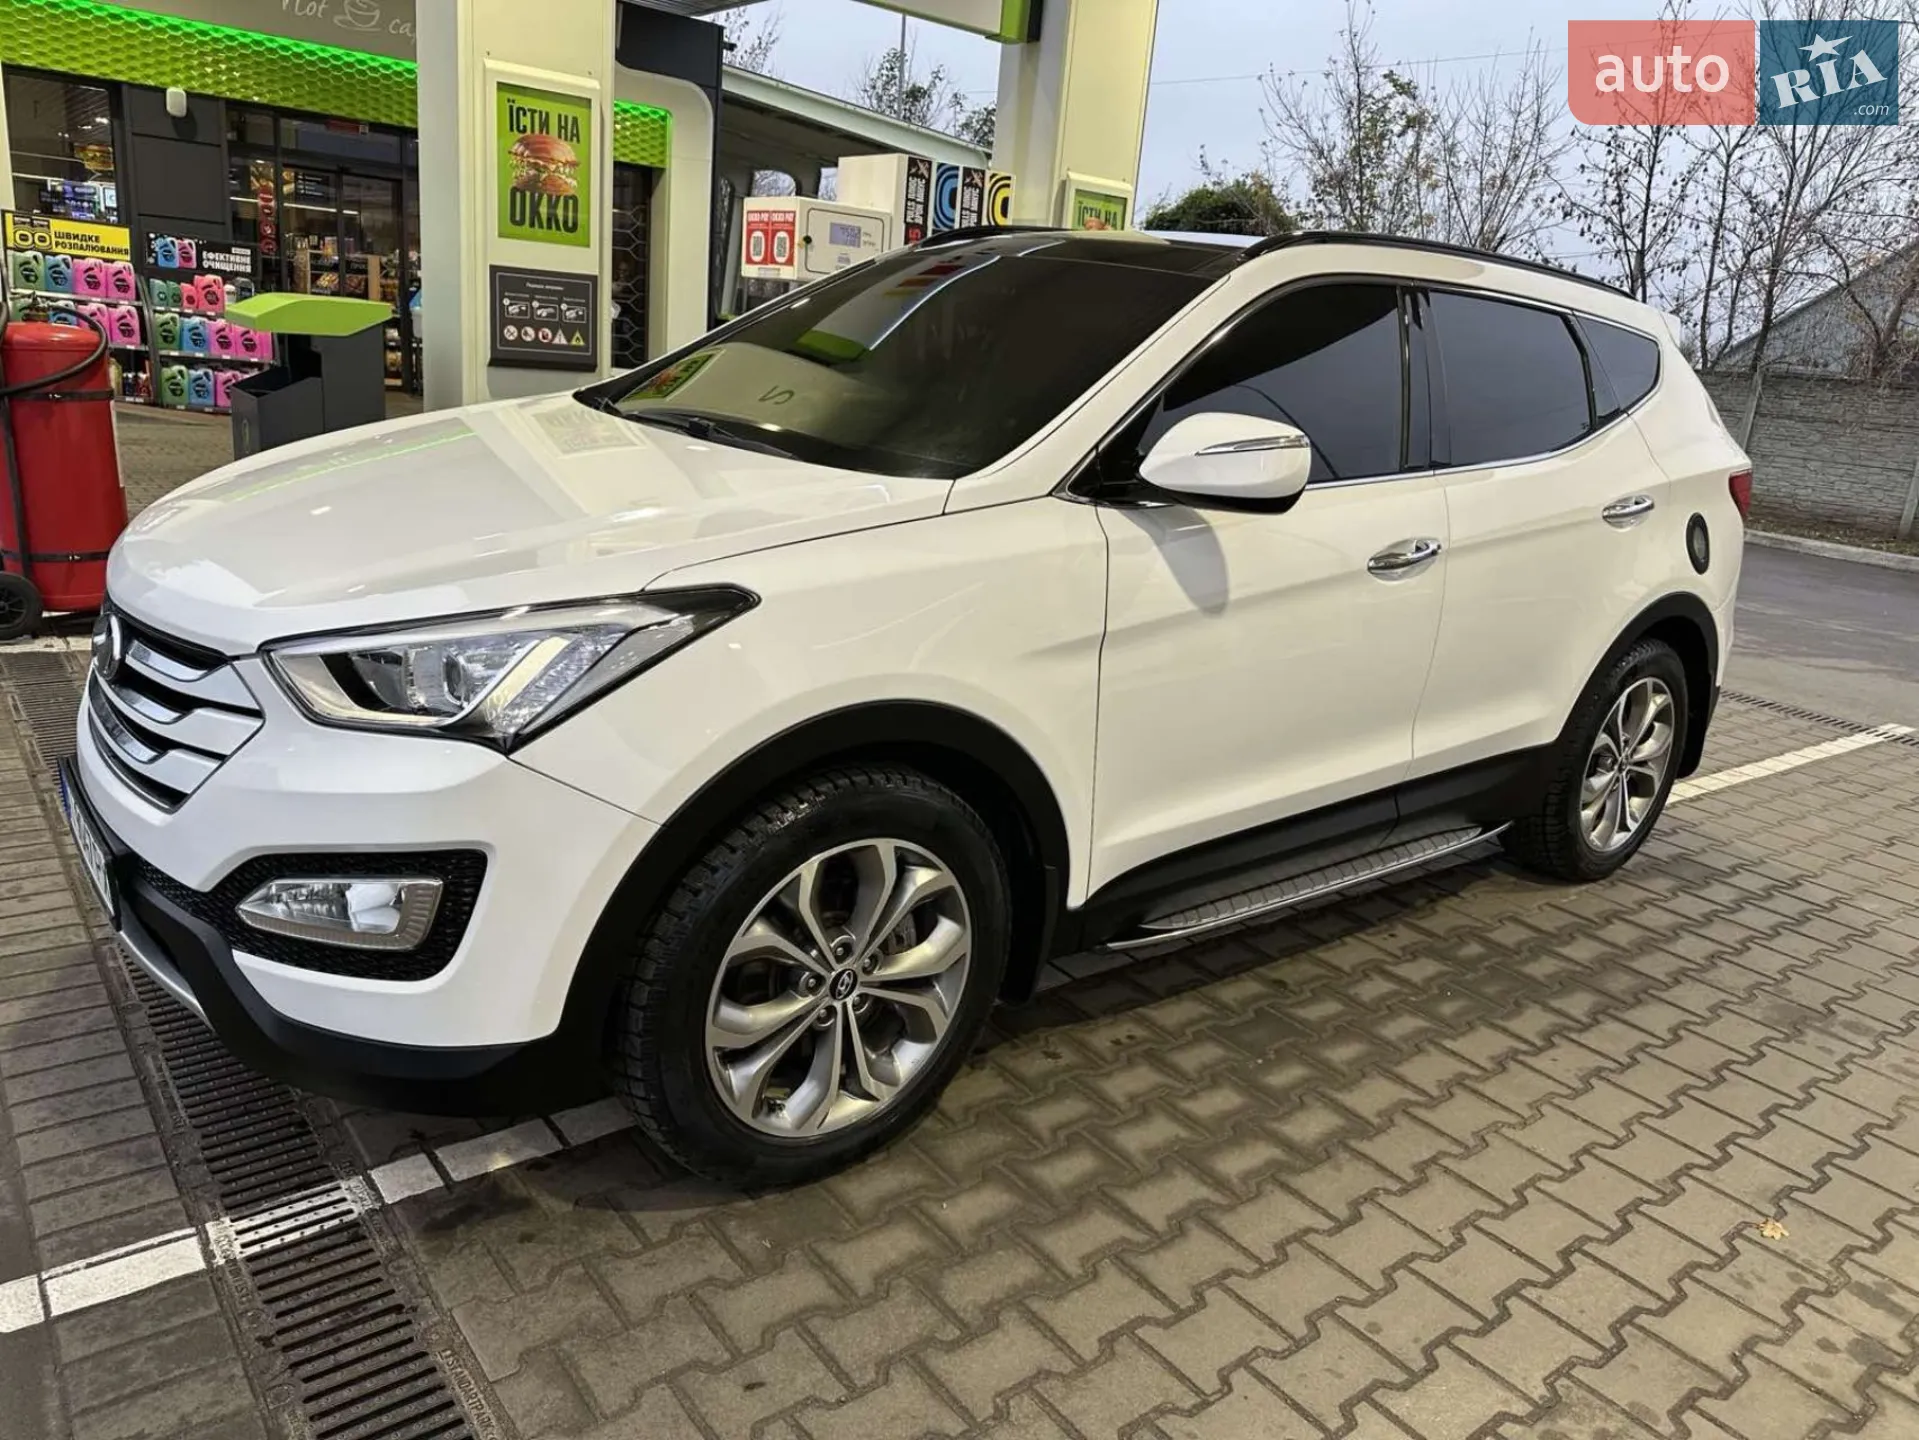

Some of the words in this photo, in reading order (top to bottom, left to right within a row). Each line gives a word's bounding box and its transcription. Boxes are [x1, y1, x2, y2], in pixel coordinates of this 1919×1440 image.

[388, 19, 416, 44] ca
[507, 98, 549, 135] ЇСТИ
[558, 114, 580, 144] НА
[510, 186, 579, 233] ОККО
[54, 231, 101, 244] ШВИДКЕ
[54, 240, 129, 256] РОЗПАЛЮВАННЯ
[202, 251, 251, 265] ЕФЕКТИВНЕ
[202, 260, 252, 273] ОЧИЩЕННЯ
